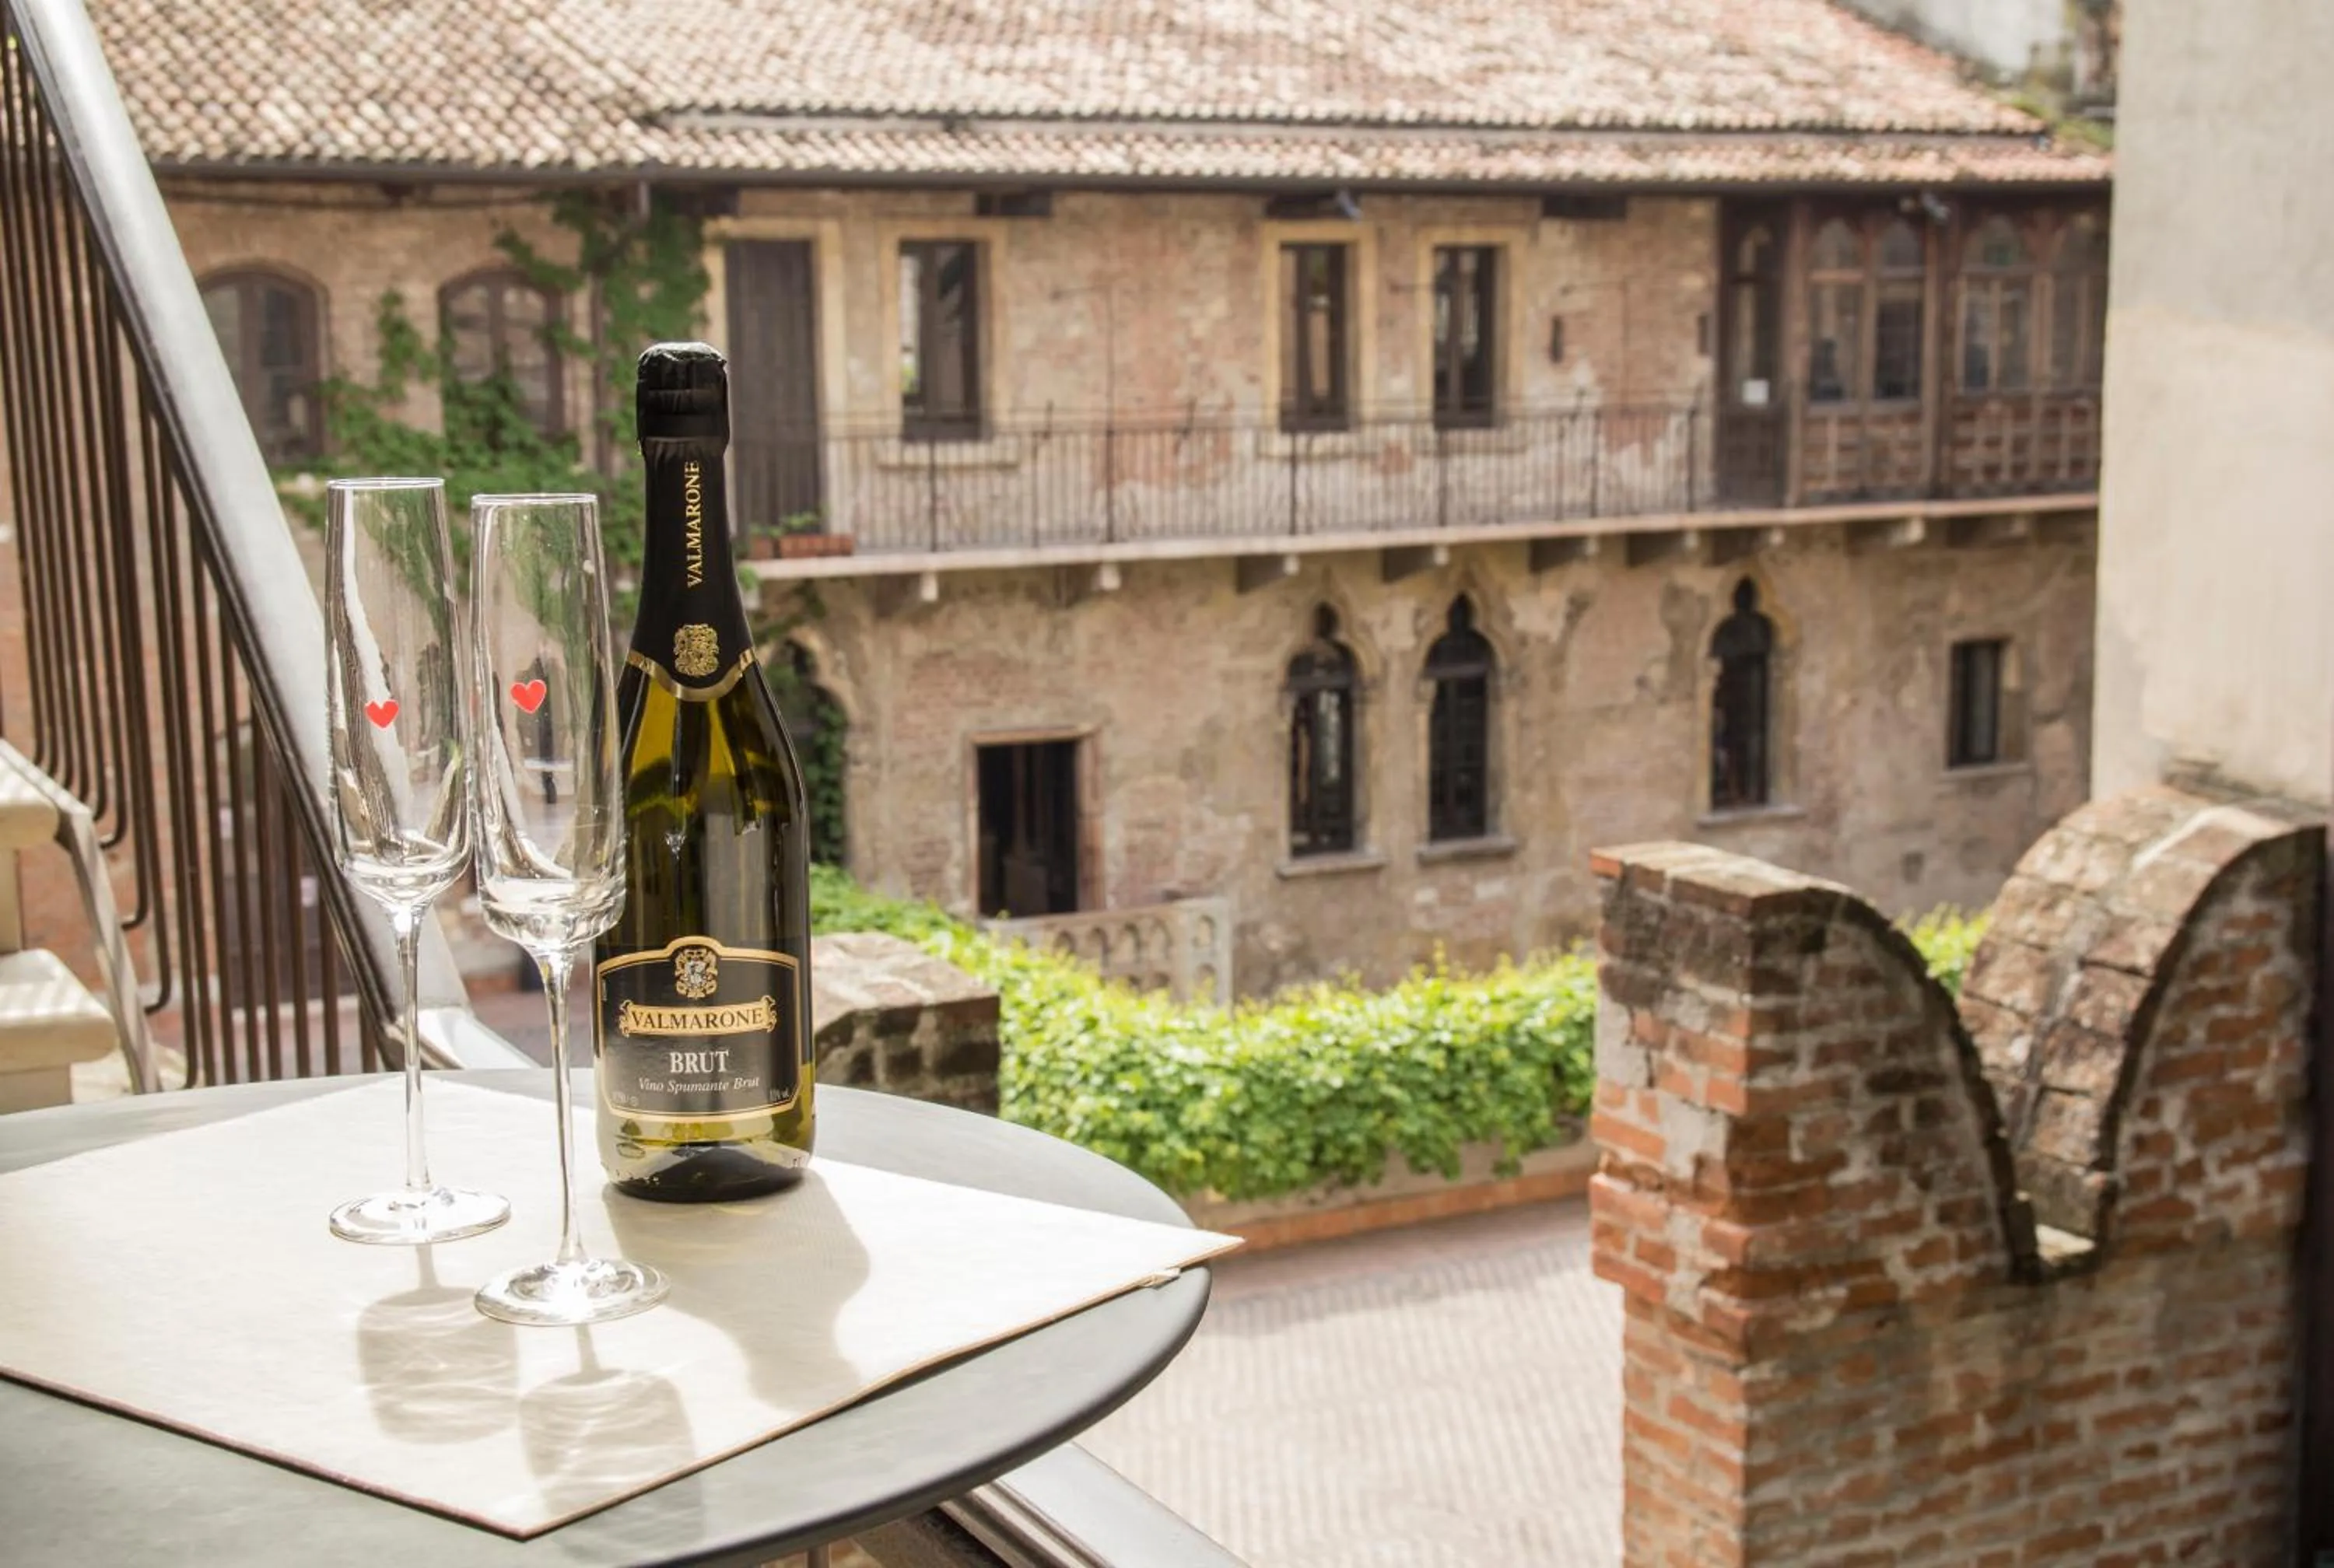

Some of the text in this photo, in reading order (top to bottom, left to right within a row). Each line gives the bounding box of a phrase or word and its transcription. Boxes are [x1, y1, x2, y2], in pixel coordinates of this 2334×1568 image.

[685, 460, 703, 589] VALMARONE
[631, 1007, 763, 1030] VALMARONE
[670, 1050, 729, 1073] BRUT
[639, 1076, 759, 1094] Vino Spumante Brut
